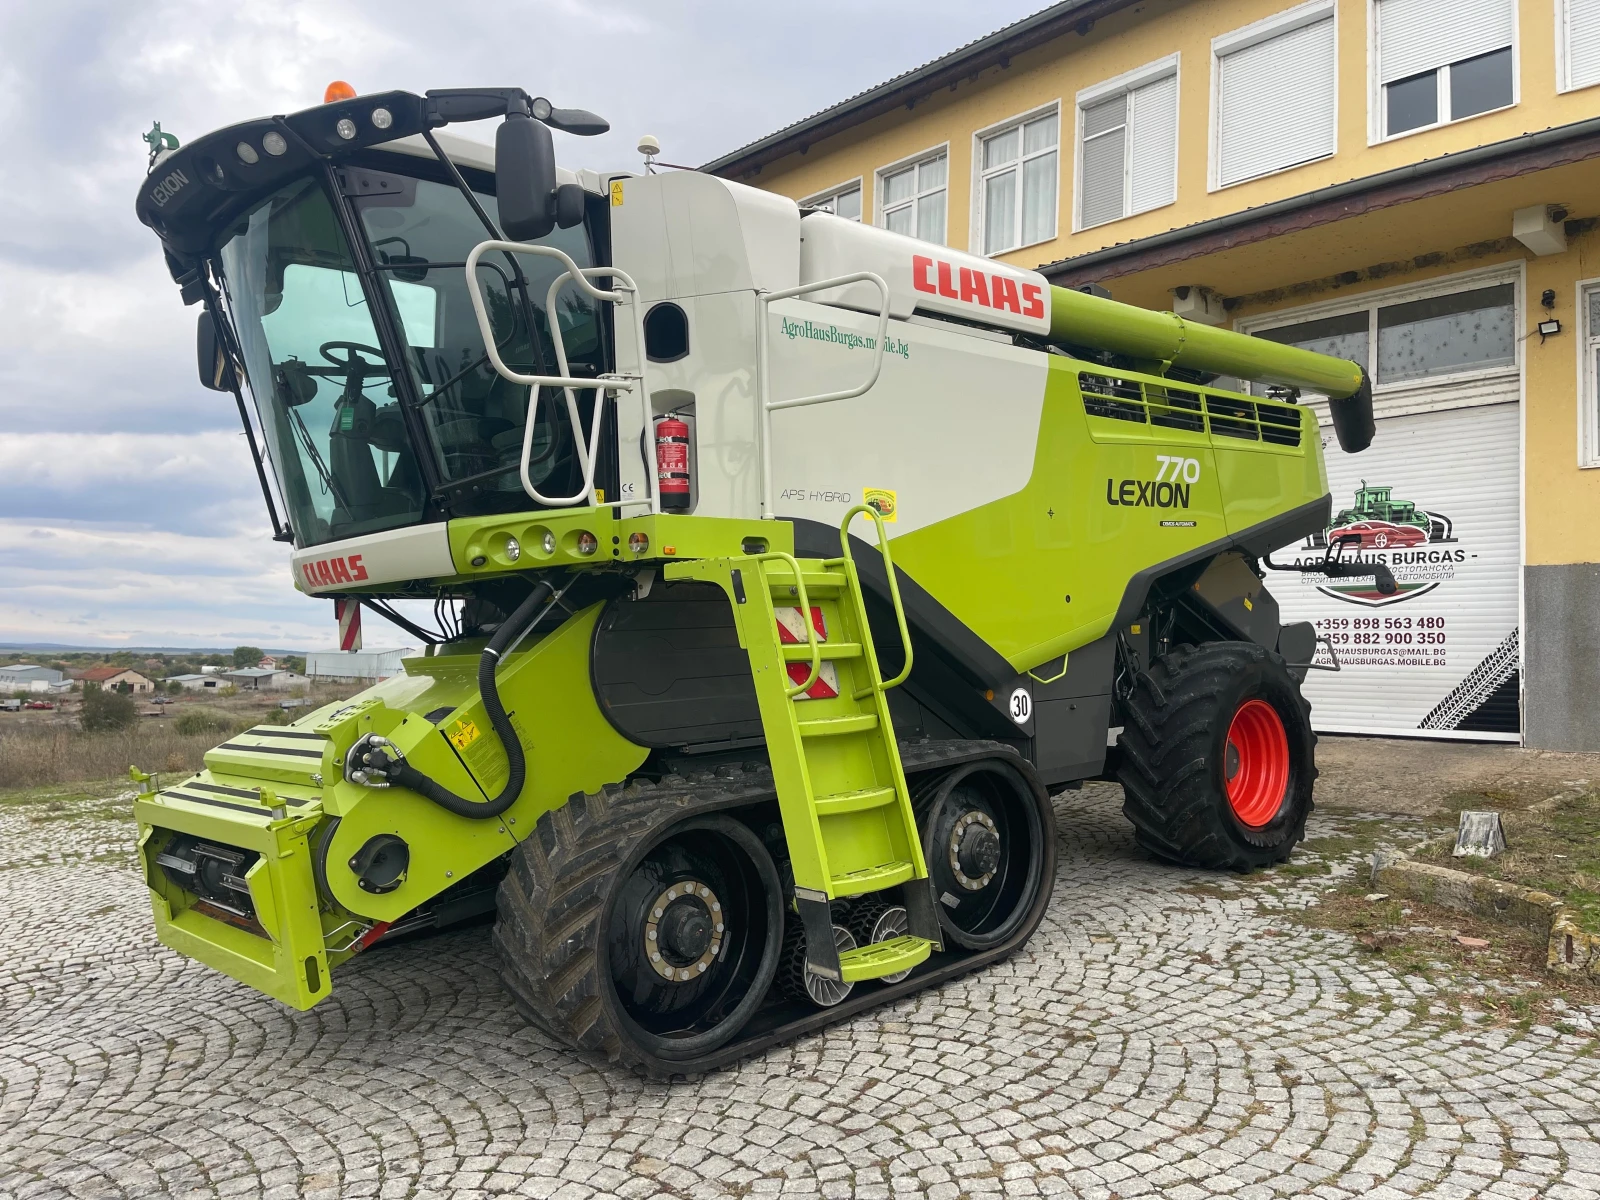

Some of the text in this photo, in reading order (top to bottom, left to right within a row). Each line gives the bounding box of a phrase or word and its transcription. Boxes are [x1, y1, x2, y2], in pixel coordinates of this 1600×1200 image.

[149, 168, 190, 207] LEXION
[912, 254, 1045, 320] CLAAS
[1156, 455, 1200, 484] 770
[780, 488, 806, 501] APS
[809, 490, 852, 503] HYBRID
[1106, 479, 1190, 509] LEXION
[1392, 549, 1466, 566] BURGAS
[302, 554, 369, 588] CLAAS
[1315, 616, 1445, 630] +359 898 563 480
[1353, 632, 1380, 645] 882
[1384, 632, 1412, 645] 900
[1416, 632, 1446, 645] 350
[1013, 694, 1028, 718] 30
